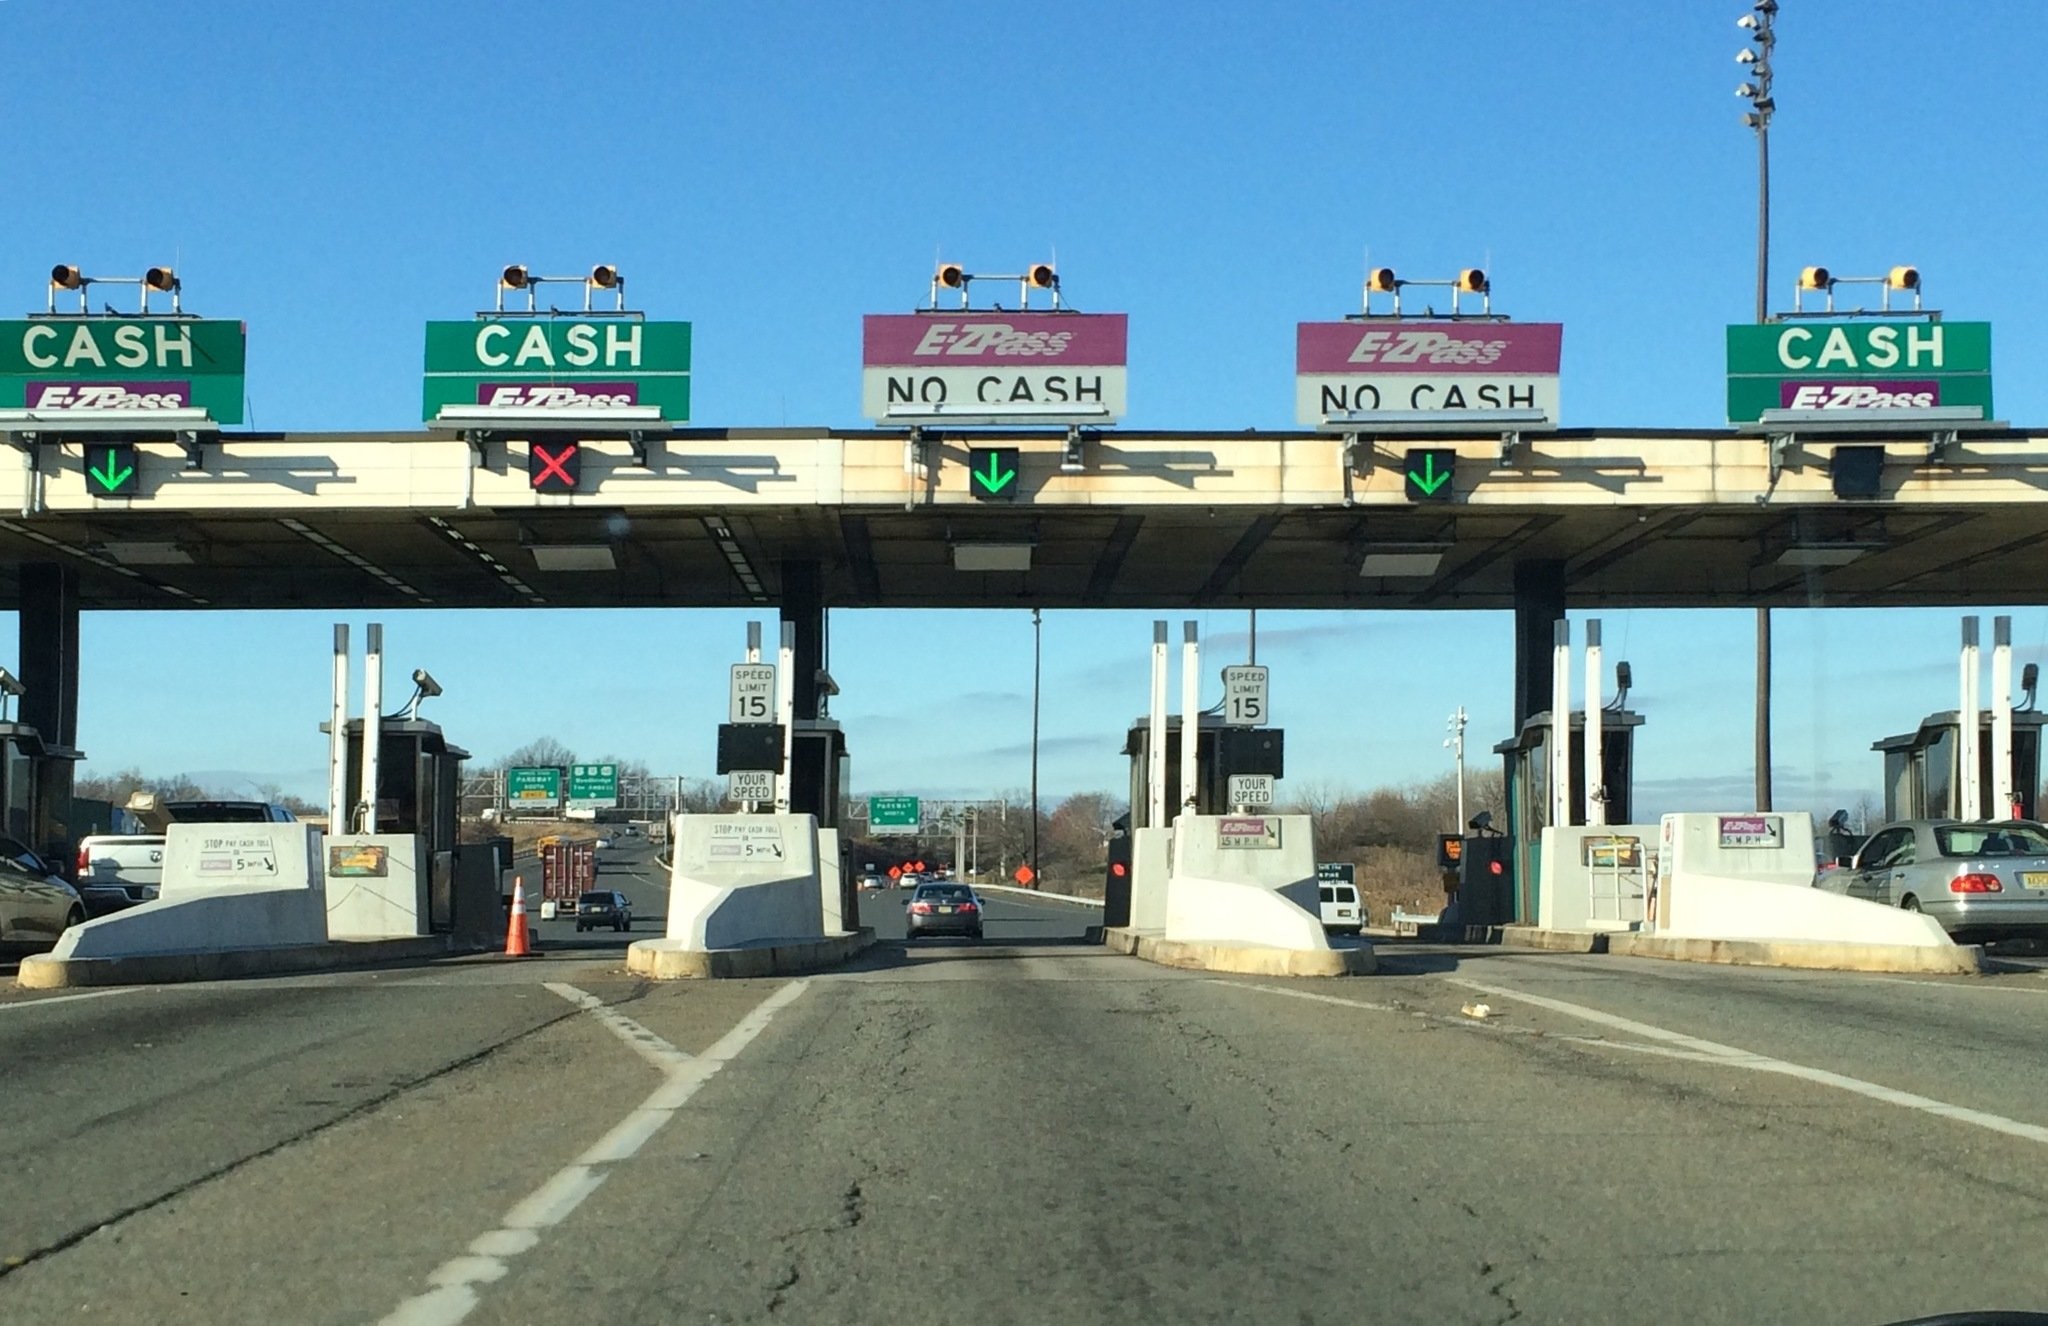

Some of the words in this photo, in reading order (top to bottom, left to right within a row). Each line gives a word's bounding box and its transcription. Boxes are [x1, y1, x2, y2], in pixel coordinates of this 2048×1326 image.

[22, 325, 193, 368] CASH
[476, 324, 642, 366] CASH
[914, 324, 1072, 355] E-ZPass
[1347, 332, 1506, 364] E-ZPass
[1778, 326, 1943, 369] CASH
[35, 386, 182, 409] E-ZPass
[888, 376, 947, 402] NO
[977, 376, 1101, 402] CASH
[1321, 384, 1380, 414] NO
[1411, 384, 1534, 409] CASH
[1790, 386, 1934, 409] E-ZPass
[736, 671, 772, 680] SPEED
[1229, 672, 1265, 681] SPEED
[738, 684, 767, 692] LIMIT
[1233, 685, 1261, 694] LIMIT
[738, 696, 767, 717] 15
[1233, 697, 1260, 718] 15
[737, 774, 766, 785] YOUR
[1239, 778, 1266, 790] YOUR
[733, 787, 770, 798] SPEED
[1234, 791, 1269, 802] SPEED
[746, 845, 754, 856] 5
[237, 858, 245, 870] 5
